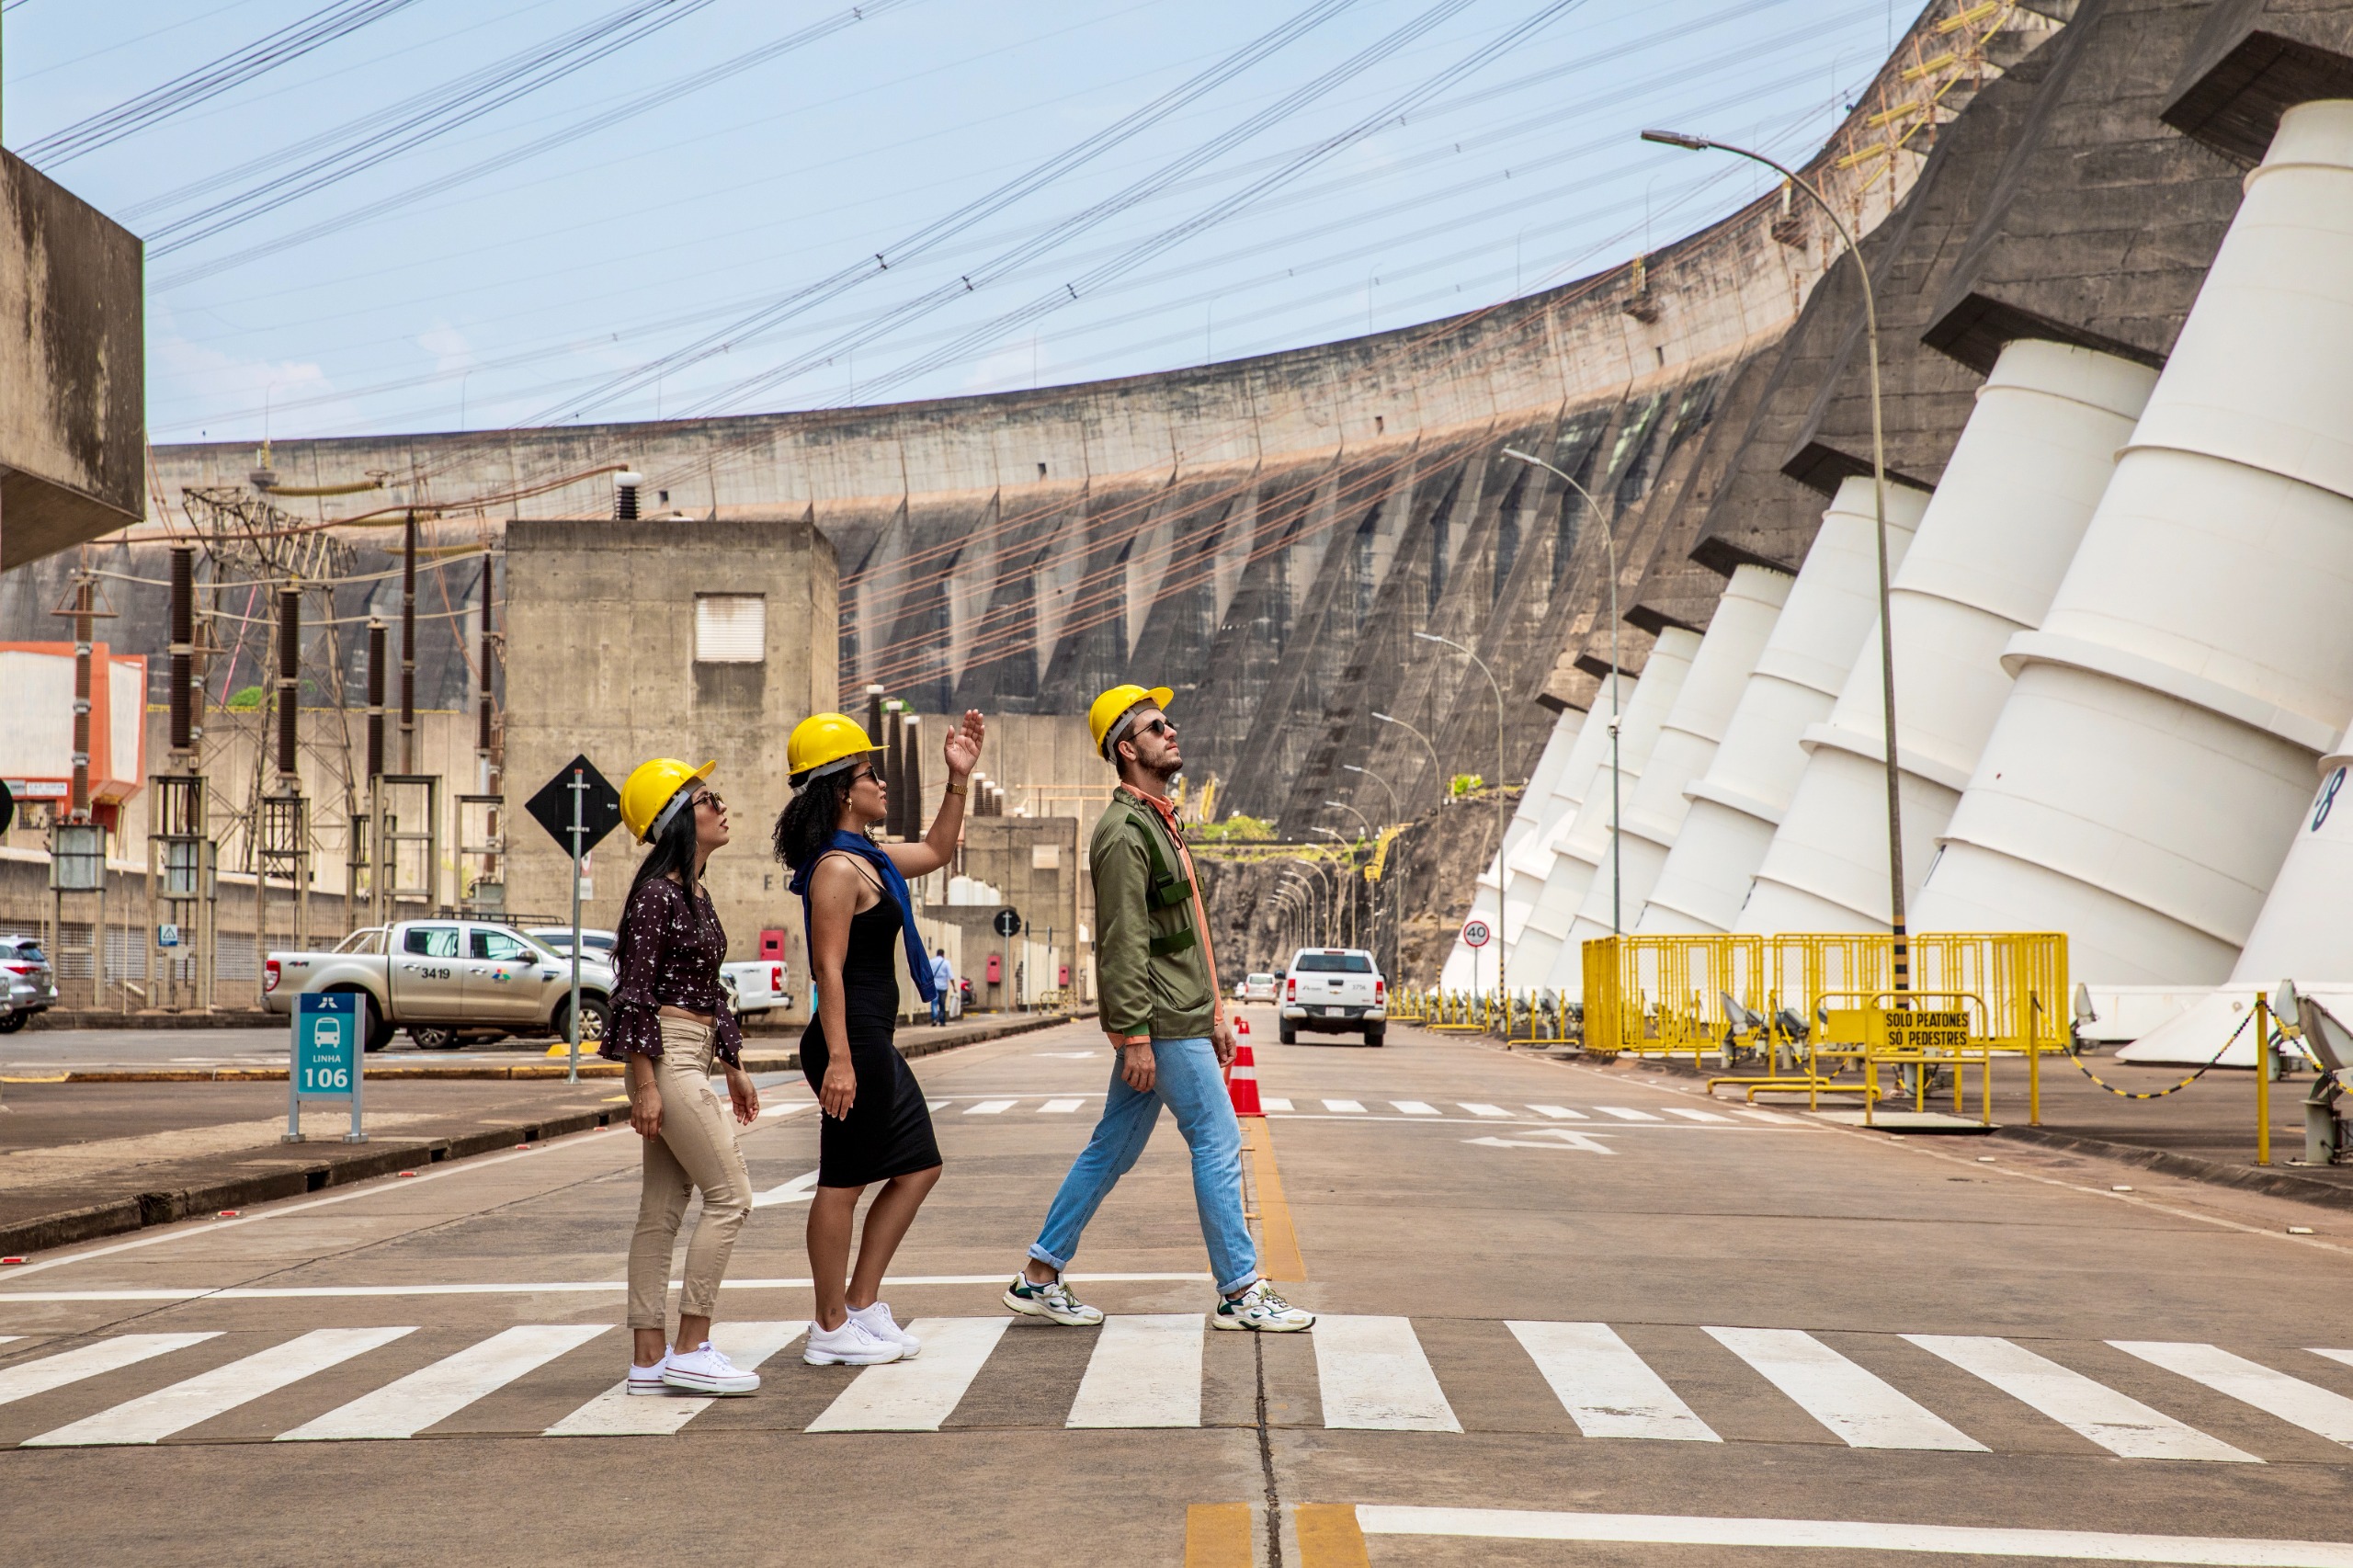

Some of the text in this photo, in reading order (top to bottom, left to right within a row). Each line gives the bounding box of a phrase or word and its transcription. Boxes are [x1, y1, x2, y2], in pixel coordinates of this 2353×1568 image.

[1467, 926, 1486, 937] 40
[421, 968, 450, 979] 3419
[1886, 1013, 1969, 1028] SOLO PEATONES
[1889, 1028, 1967, 1046] SÓ PEDESTRES
[313, 1054, 342, 1063] LINHA
[305, 1067, 348, 1088] 106
